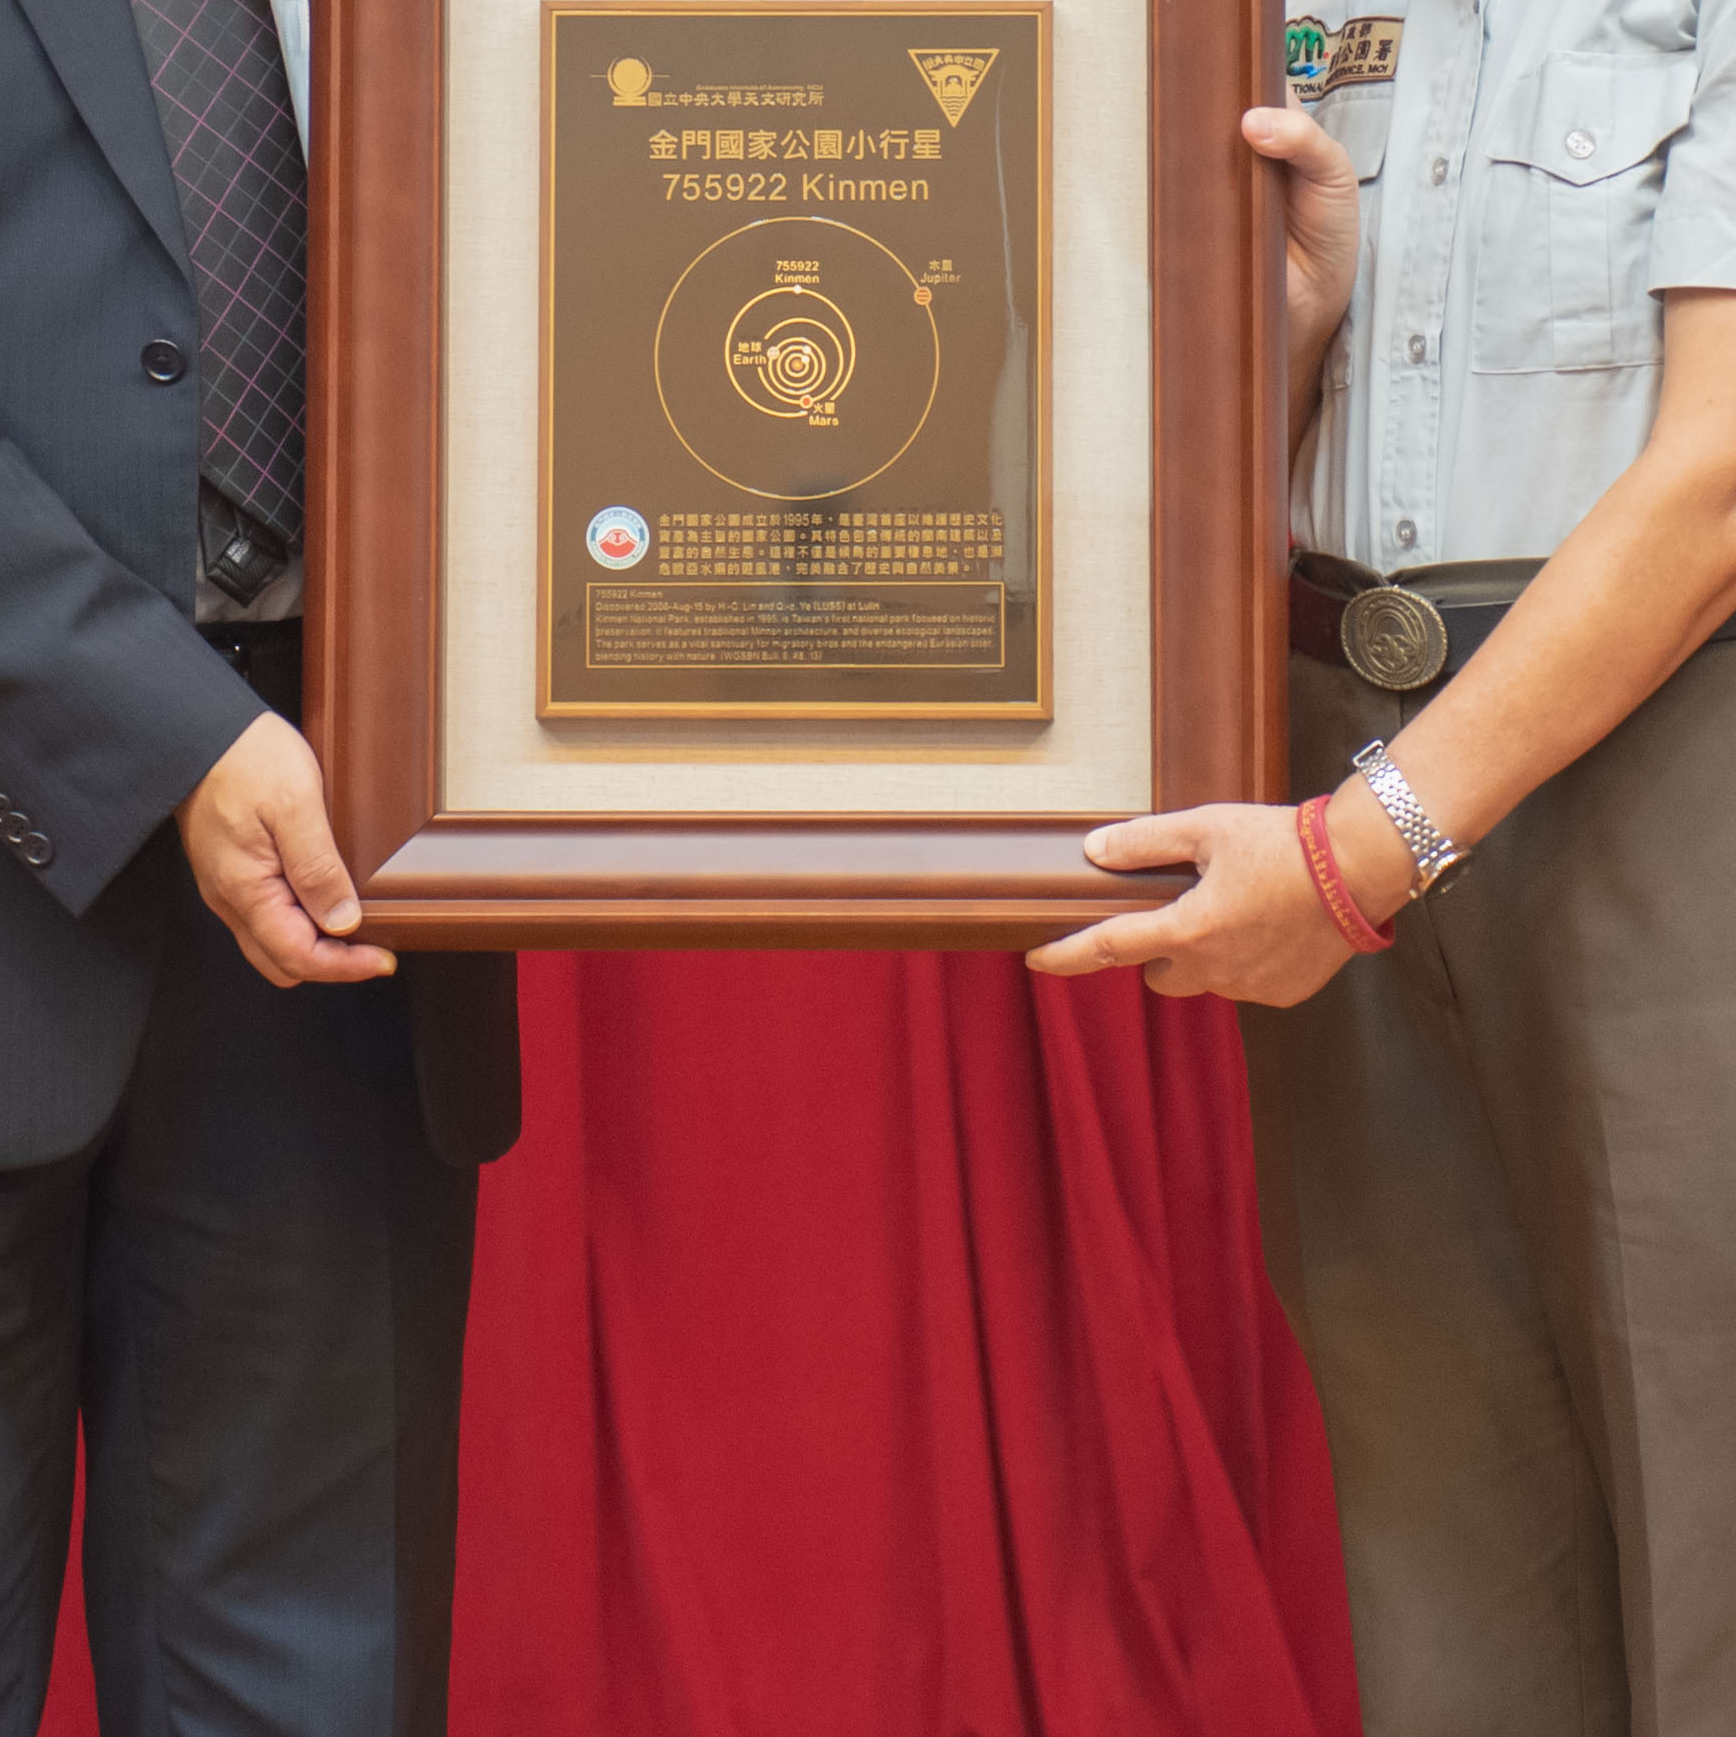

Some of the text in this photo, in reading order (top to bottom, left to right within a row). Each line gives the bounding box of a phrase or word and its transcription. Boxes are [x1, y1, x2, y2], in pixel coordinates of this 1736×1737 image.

[648, 91, 824, 107] 國立中央大學天文研究所
[648, 130, 942, 161] 金門國家公園小行星
[663, 173, 929, 201] 755922 Kinmen
[776, 260, 819, 271] 755922
[775, 274, 820, 284] Kinmen
[920, 273, 961, 285] Jupiter
[738, 341, 762, 353] 地球
[733, 354, 766, 365] Earth
[809, 415, 839, 426] Mars
[630, 590, 663, 600] Kinmen
[758, 602, 775, 612] and
